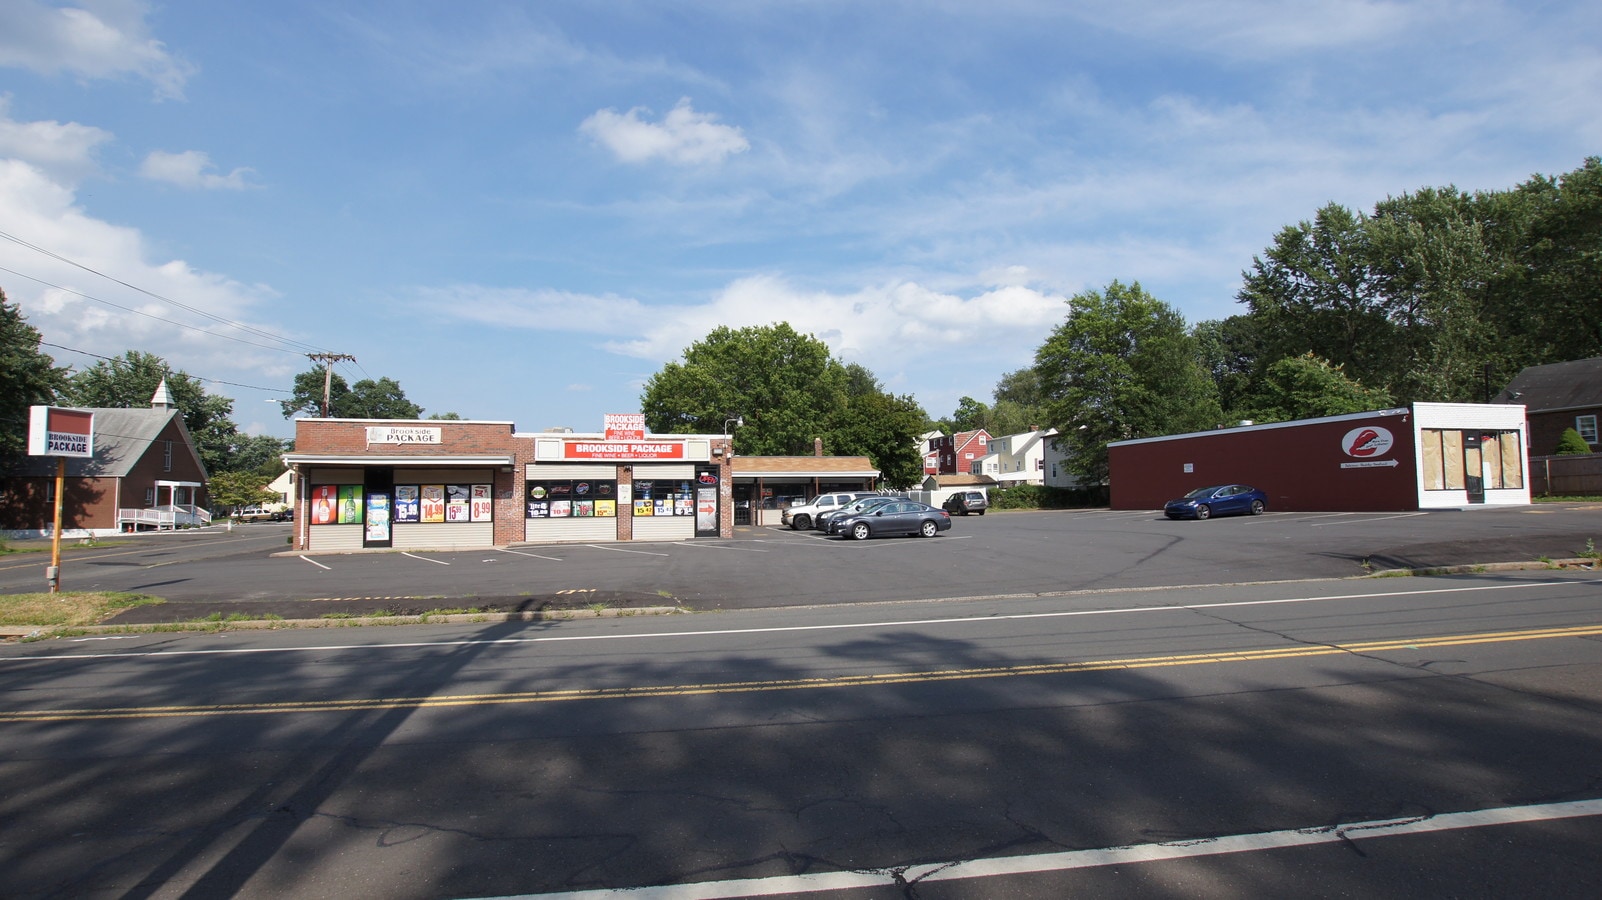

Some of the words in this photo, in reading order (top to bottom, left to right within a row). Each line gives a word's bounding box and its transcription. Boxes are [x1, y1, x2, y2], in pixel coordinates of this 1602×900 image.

[606, 415, 644, 423] BROOKSIDE
[49, 433, 87, 443] BROOKSIDE
[48, 441, 87, 452] PACKAGE
[576, 444, 628, 452] BROOKSIDE
[631, 444, 672, 452] PACKAGE
[474, 502, 490, 518] 8.99
